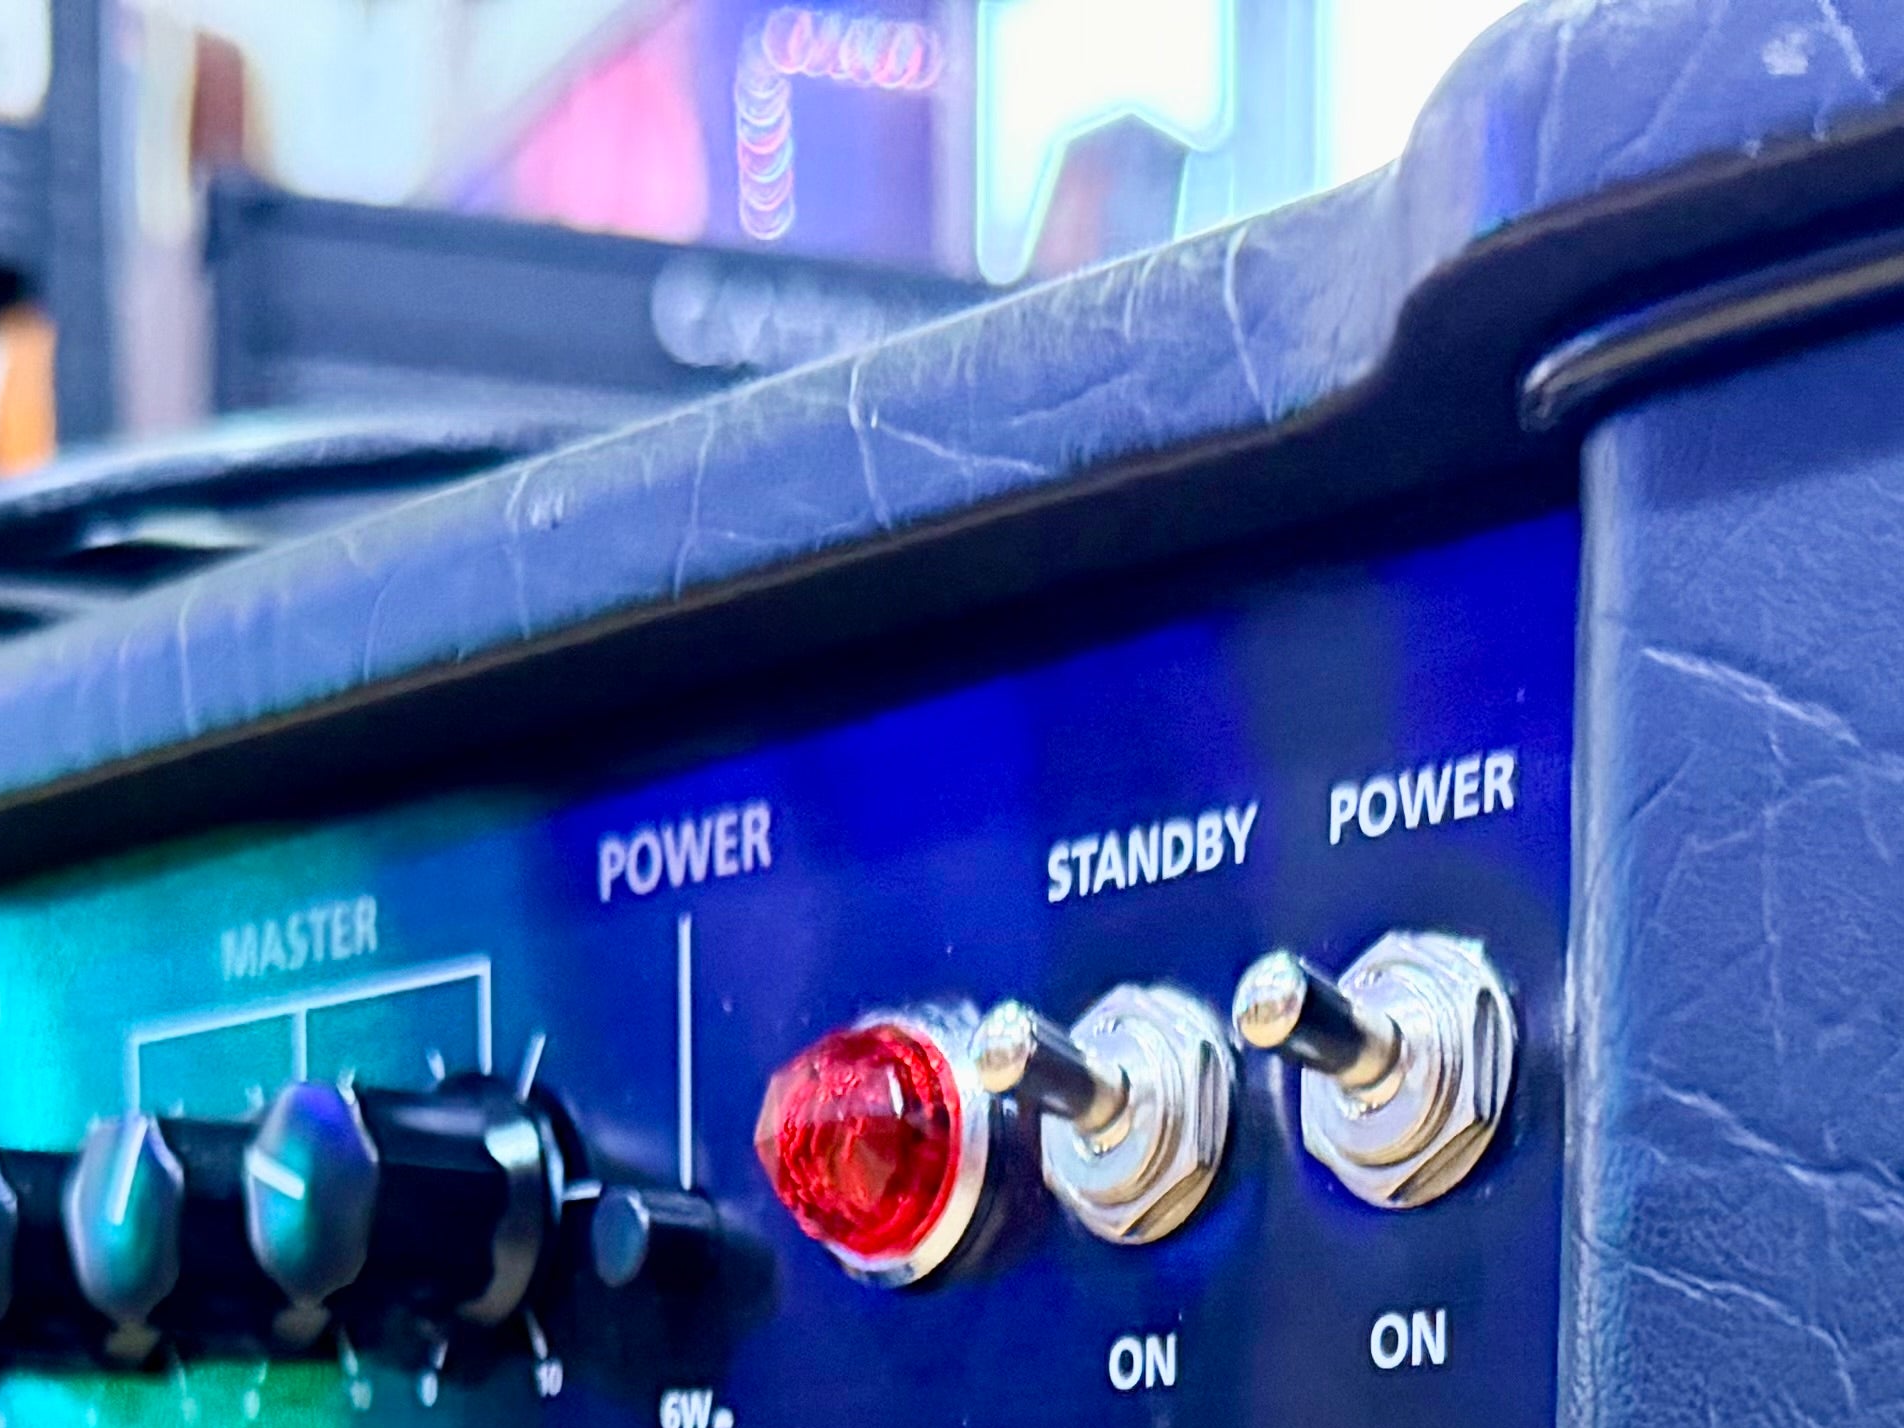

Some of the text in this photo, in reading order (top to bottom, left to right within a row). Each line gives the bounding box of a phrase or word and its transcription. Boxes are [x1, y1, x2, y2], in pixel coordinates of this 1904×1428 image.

[1328, 752, 1517, 845] POWER
[598, 801, 773, 903] POWER
[1046, 803, 1259, 903] STANDBY
[220, 894, 379, 981] MASTER
[1108, 1335, 1176, 1391] ON
[1369, 1310, 1447, 1369] ON
